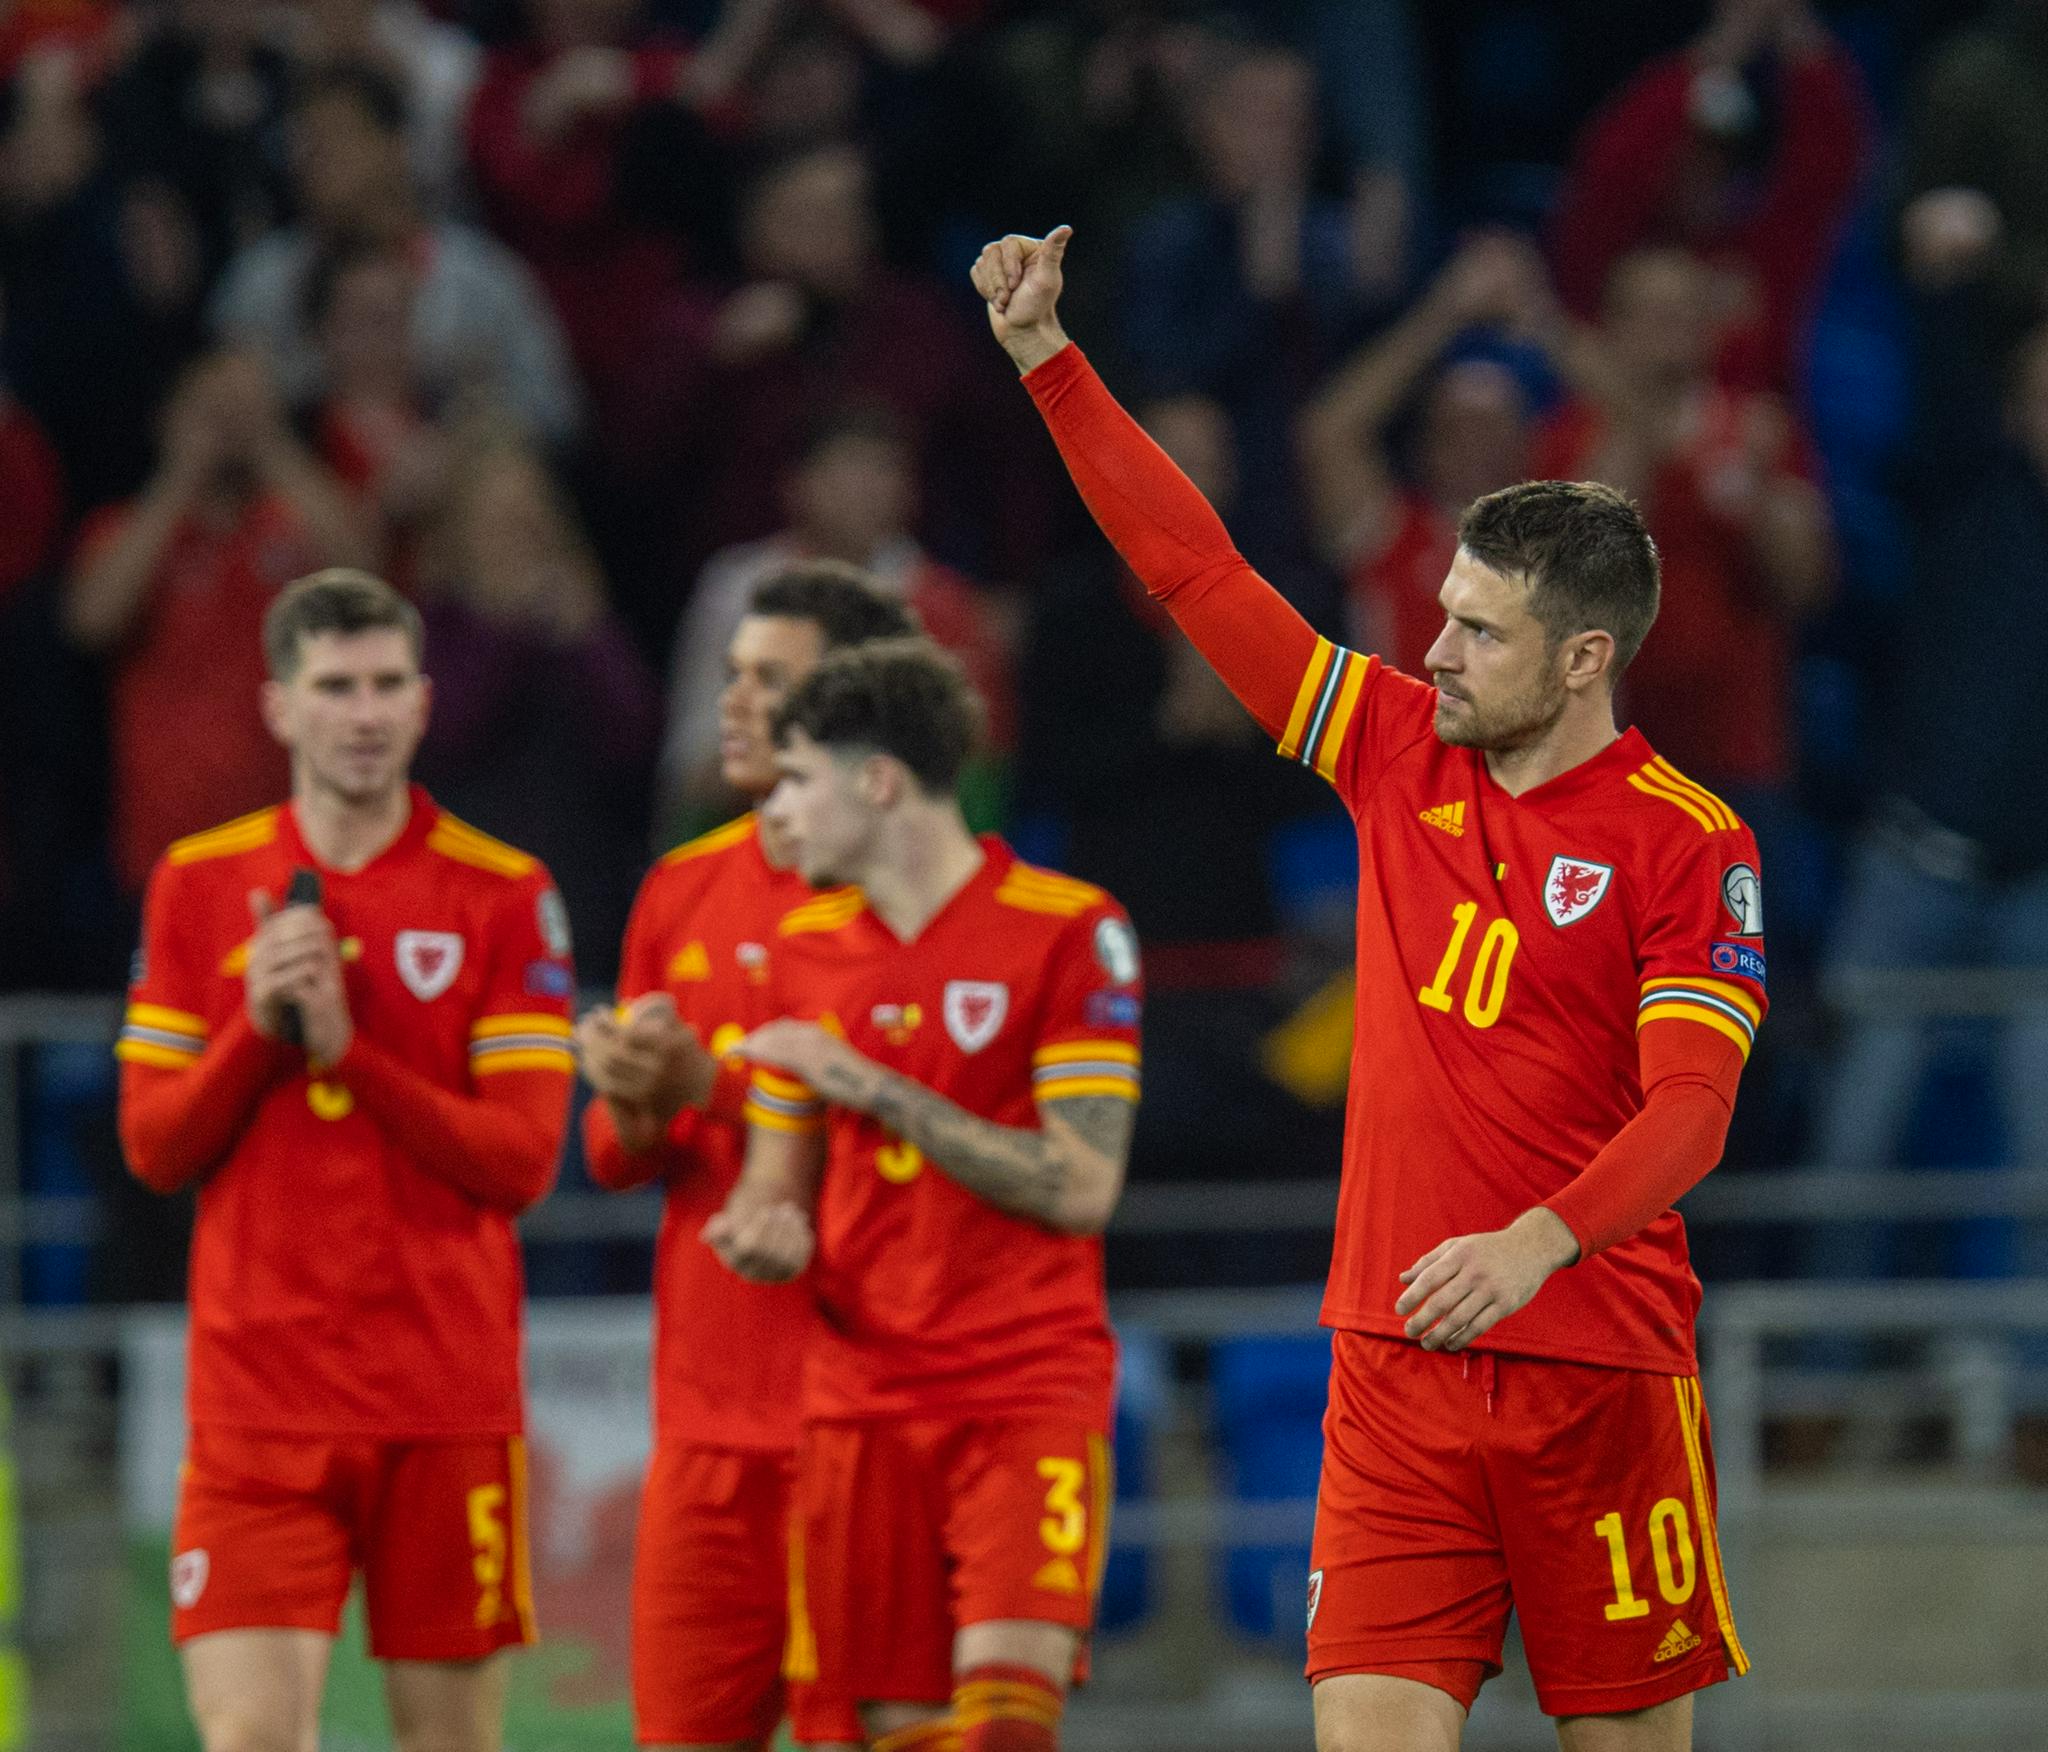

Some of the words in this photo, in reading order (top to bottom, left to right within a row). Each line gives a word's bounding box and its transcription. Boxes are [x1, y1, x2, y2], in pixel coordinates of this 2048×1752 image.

[1419, 811, 1465, 838] adidas
[1418, 901, 1520, 1029] 10
[466, 1483, 507, 1586] 5
[1036, 1457, 1087, 1553] 3
[1594, 1497, 1696, 1622] 10
[1653, 1634, 1701, 1663] adidas
